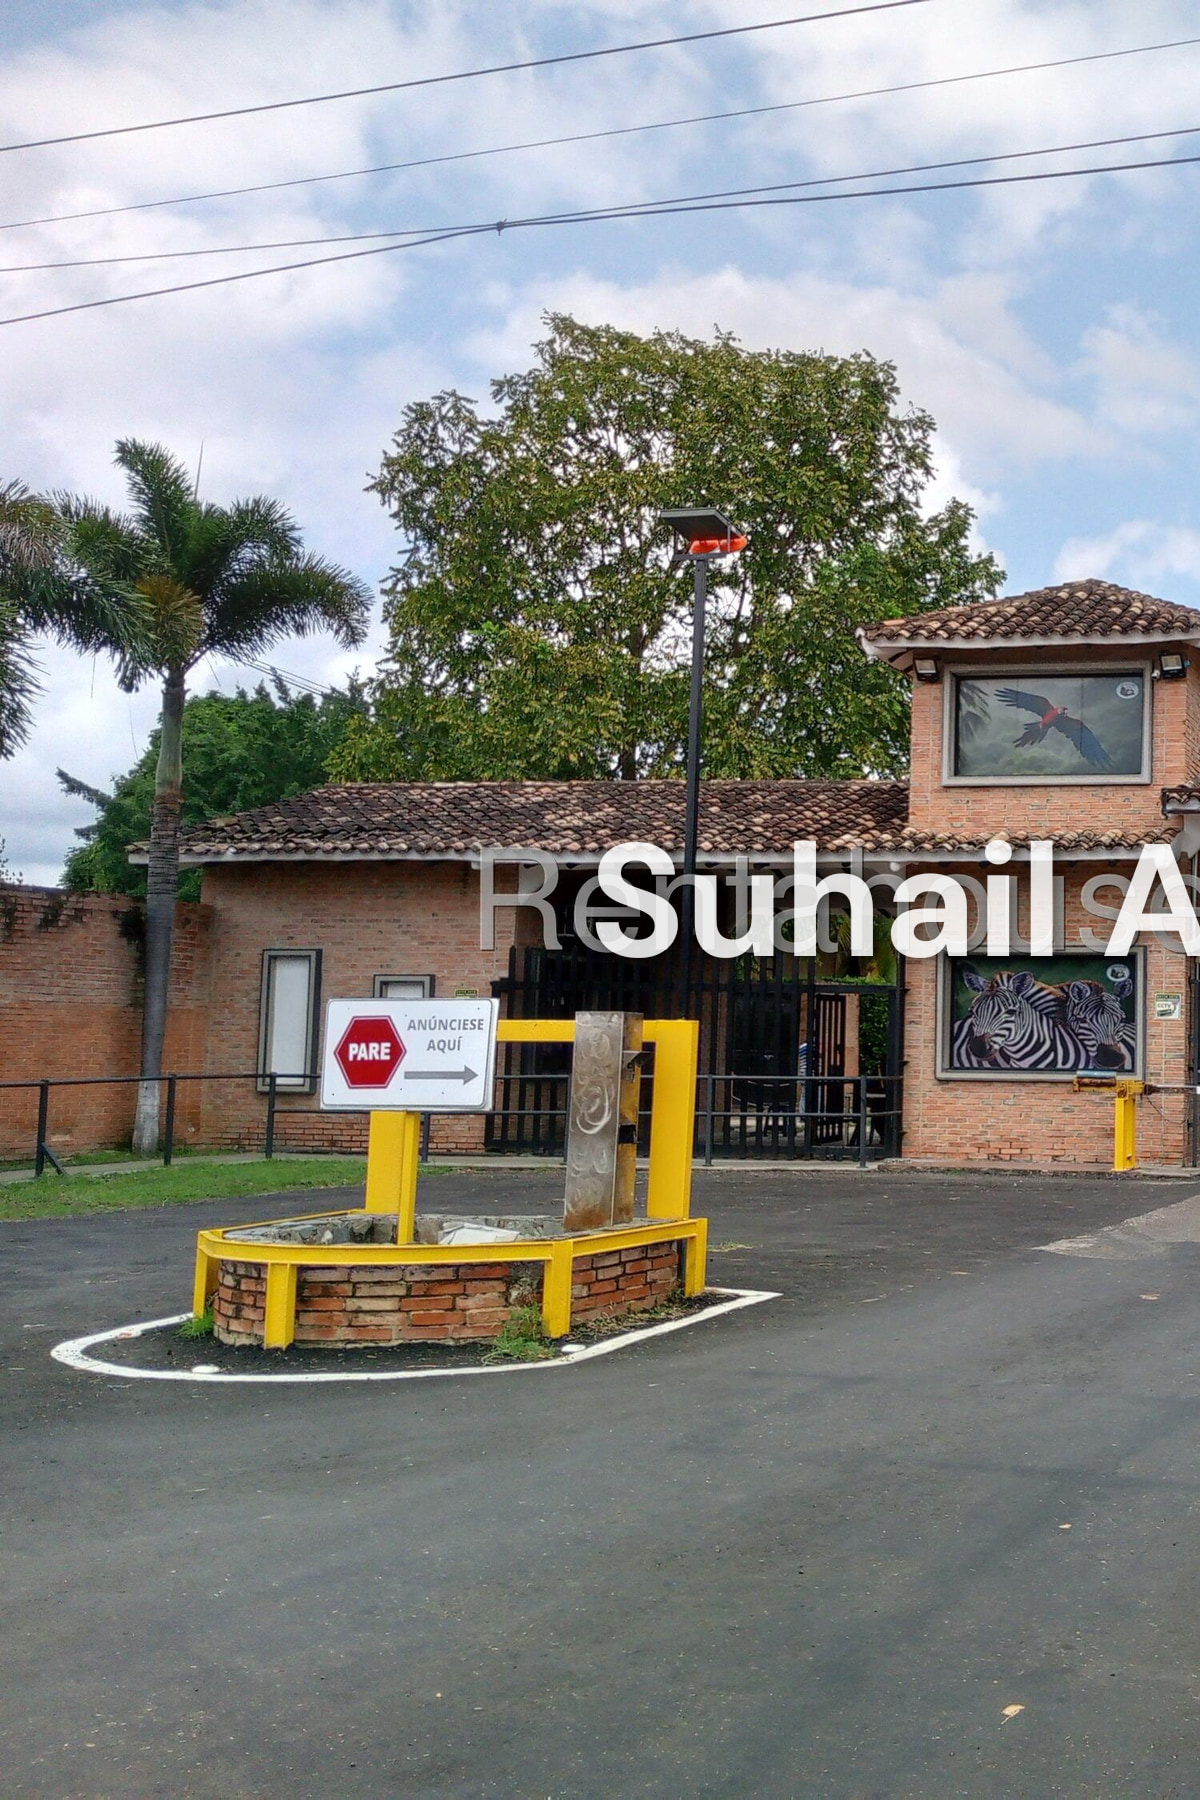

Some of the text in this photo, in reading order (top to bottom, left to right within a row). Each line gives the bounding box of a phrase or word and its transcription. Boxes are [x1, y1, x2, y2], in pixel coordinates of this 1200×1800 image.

[407, 1016, 484, 1031] ANÚNCIESE
[348, 1042, 391, 1061] PARE
[427, 1036, 463, 1053] AQUÍ
